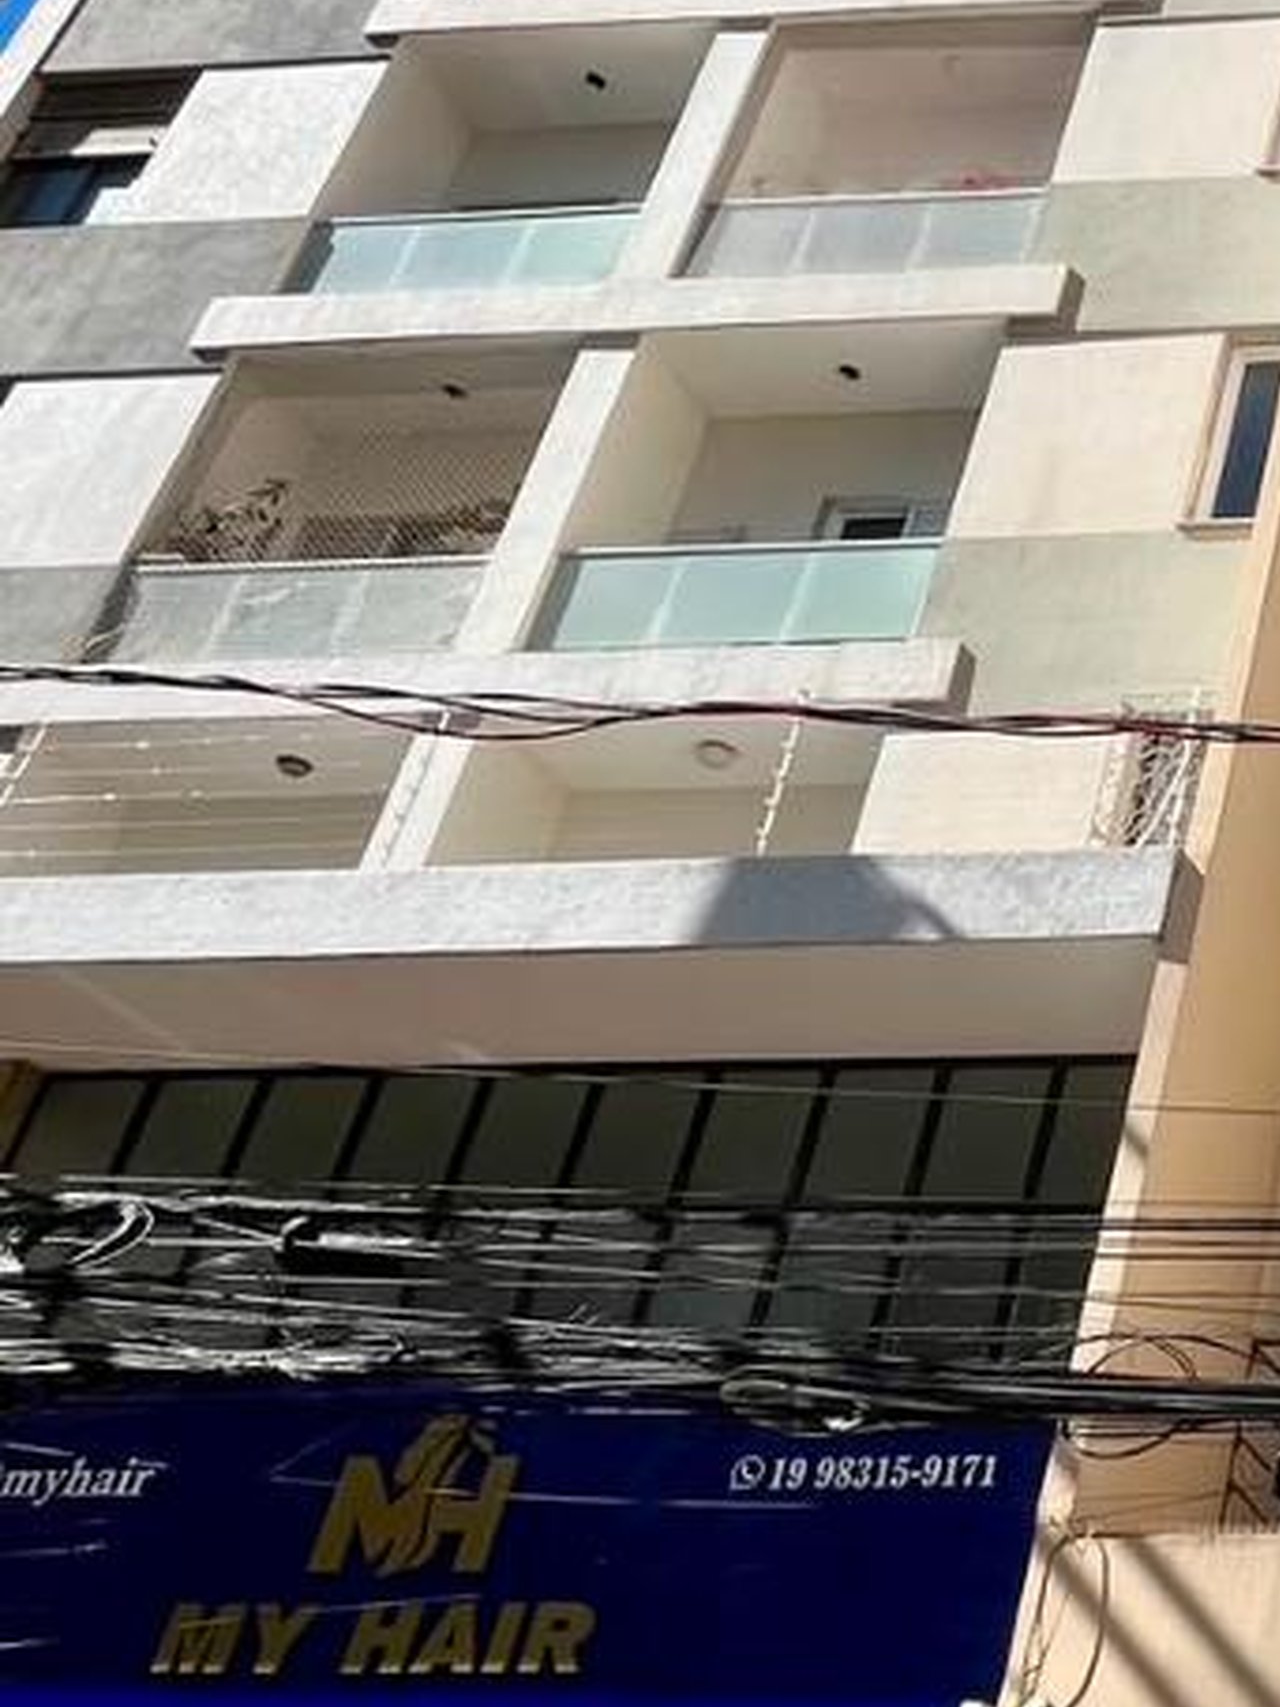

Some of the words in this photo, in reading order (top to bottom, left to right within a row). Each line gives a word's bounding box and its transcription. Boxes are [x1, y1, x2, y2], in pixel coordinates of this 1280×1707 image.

[0, 1456, 156, 1506] myhair
[768, 1455, 807, 1490] 19
[813, 1454, 997, 1489] 98315-9171
[150, 1602, 322, 1674] MY
[338, 1599, 597, 1674] HAIR
